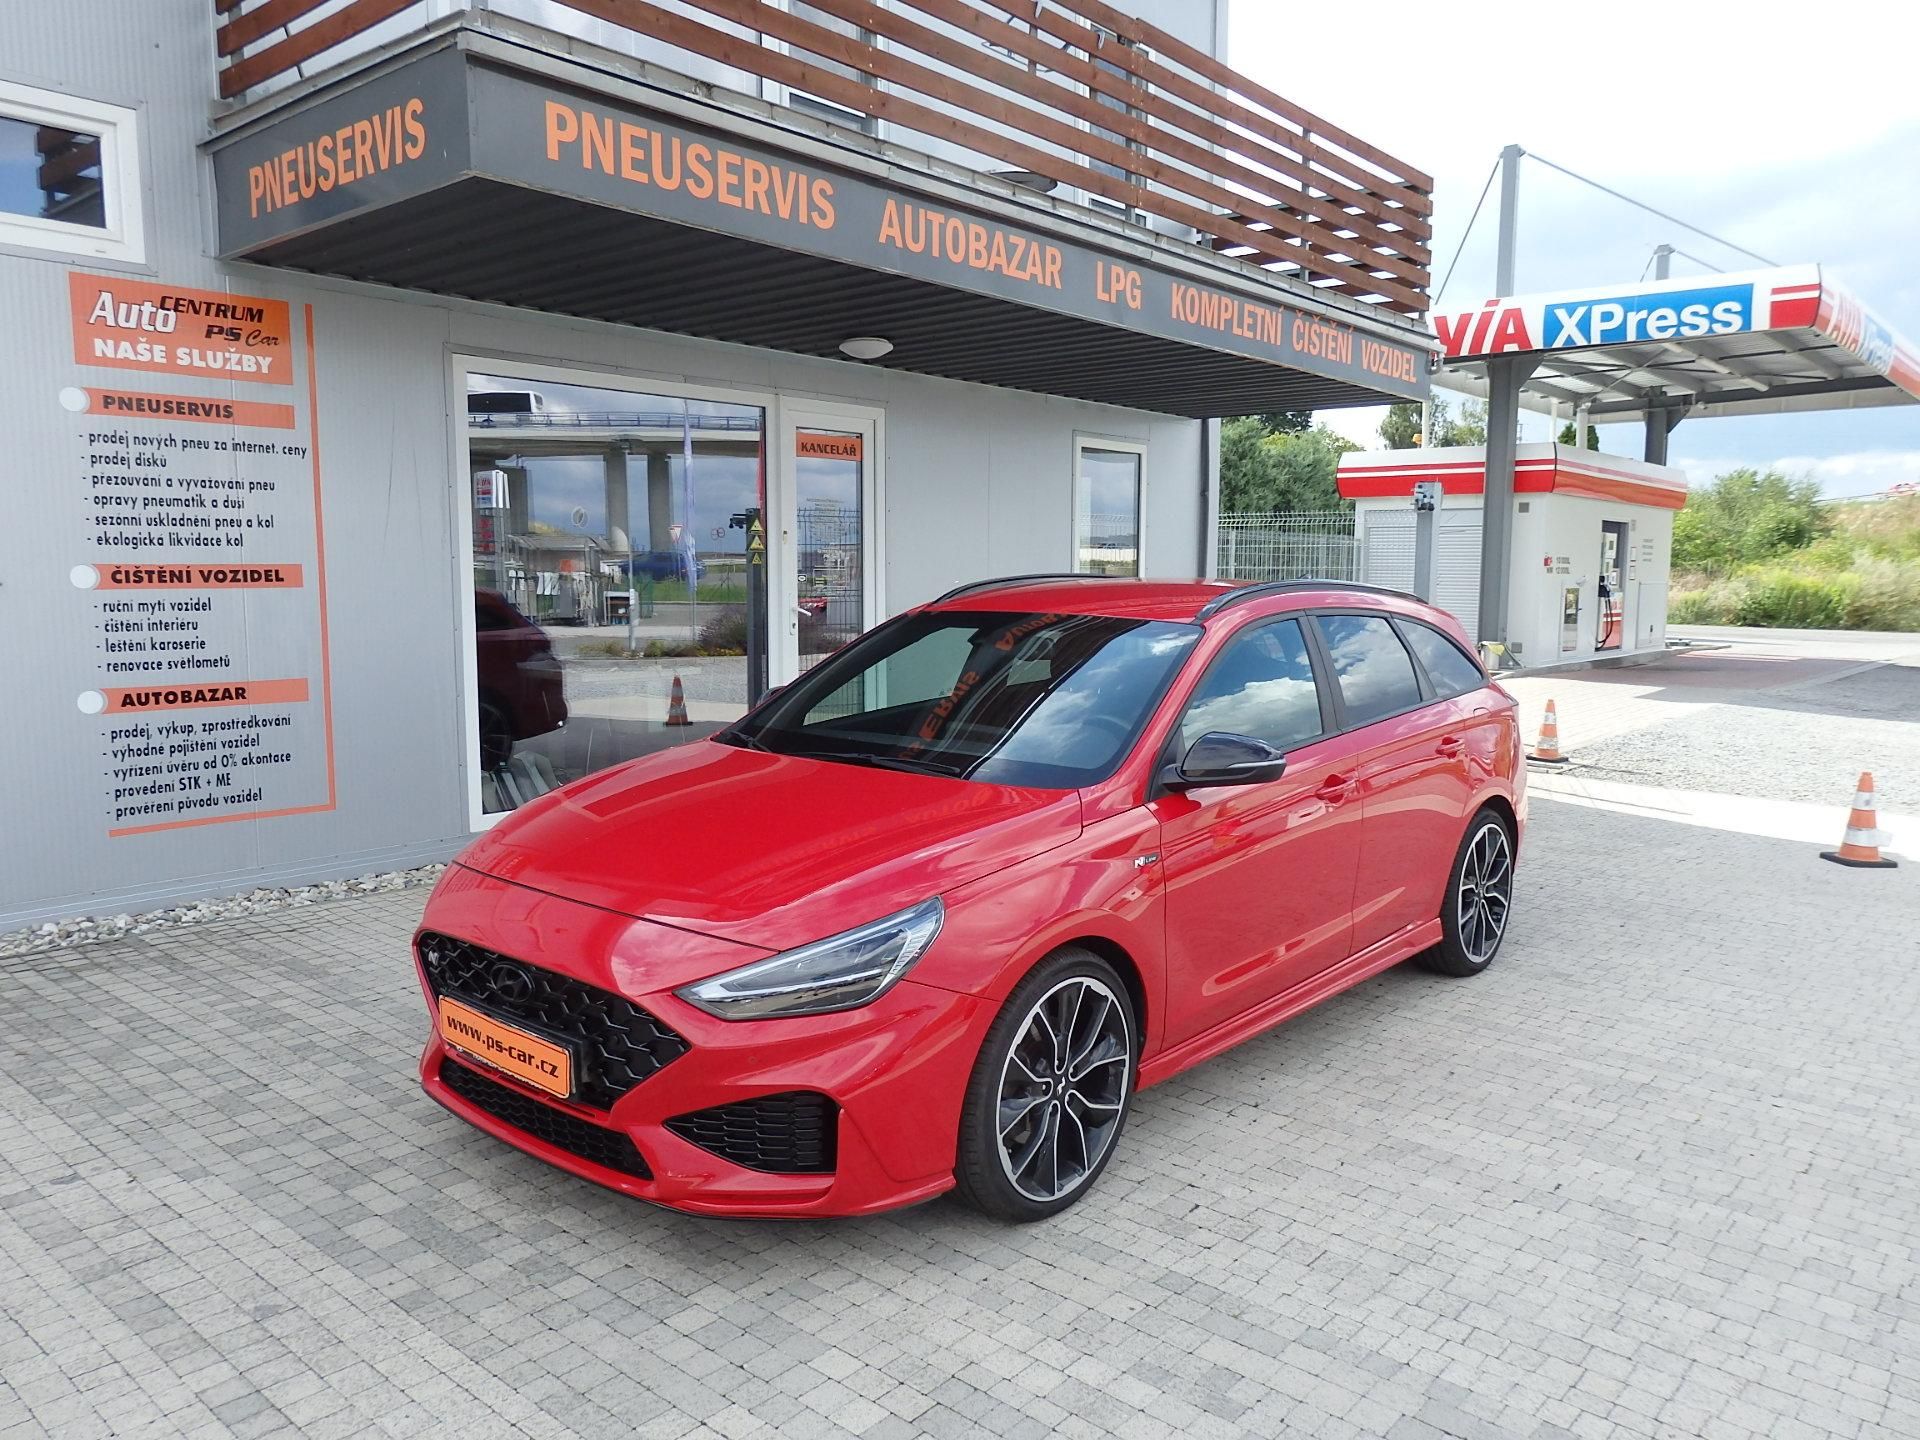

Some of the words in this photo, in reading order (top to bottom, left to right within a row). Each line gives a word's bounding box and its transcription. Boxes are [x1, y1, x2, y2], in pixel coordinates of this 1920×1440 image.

[249, 97, 426, 219] PNEUSERVIS
[544, 99, 836, 230] PNEUSERVIS
[879, 198, 1062, 289] AUTOBAZAR
[1096, 261, 1142, 310] LPG
[1171, 282, 1283, 346] KOMPLETNÍ
[1292, 310, 1354, 365] ČIŠTĚNÍ
[1361, 340, 1417, 384] VOZIDEL
[88, 290, 177, 333] Auto
[159, 295, 264, 323] CENTRUM
[205, 325, 243, 341] PS
[245, 330, 280, 347] Car
[1551, 301, 1743, 348] XPress
[94, 337, 167, 364] NAŠE
[176, 348, 272, 374] SLUŽBY
[101, 395, 233, 418] PNEUSERVIS
[89, 430, 129, 448] prodej
[134, 433, 177, 450] nových
[182, 439, 209, 451] pneu
[214, 441, 227, 450] za
[232, 438, 278, 454] internet.
[283, 446, 307, 459] ceny
[801, 443, 857, 457] KANCELÁŘ
[91, 451, 130, 469] prodej
[135, 452, 167, 467] disků
[92, 472, 161, 488] přezouvání
[166, 478, 173, 487] a
[178, 477, 244, 492] vyvažování
[249, 481, 275, 493] pneu
[94, 495, 138, 510] opravy
[143, 494, 206, 510] pneumatik
[211, 499, 218, 508] a
[215, 518, 242, 530] pneu
[246, 518, 253, 528] a
[257, 514, 274, 528] kol
[96, 531, 164, 550] ekologická
[169, 532, 221, 547] likvidace
[226, 532, 243, 547] kol
[111, 565, 192, 584] ČIŠTĚNÍ
[198, 569, 284, 583] VOZIDEL
[103, 600, 133, 612] ruční
[170, 597, 212, 612] vozidel
[105, 618, 143, 632] čištění
[148, 617, 198, 631] interiéru
[106, 638, 146, 652] leštění
[151, 636, 206, 650] karoserie
[107, 661, 163, 672] renovace
[168, 655, 230, 670] světlometů
[121, 687, 246, 707] AUTOBAZAR
[111, 723, 152, 743] prodej,
[157, 721, 197, 738] výkup,
[202, 714, 291, 735] zprostředkování
[112, 742, 164, 762] výhodné
[170, 738, 216, 757] pojištění
[221, 733, 259, 749] vozidel
[114, 761, 162, 781] vyřízení
[204, 755, 216, 769] od
[221, 753, 237, 768] 0%
[242, 752, 291, 766] akontace
[115, 780, 174, 802] provedení
[179, 776, 201, 791] STK
[216, 773, 231, 787] ME
[116, 799, 173, 821] prověření
[178, 793, 218, 813] původu
[223, 787, 262, 804] vozidel
[447, 1015, 559, 1079] www.ps-car.cz
